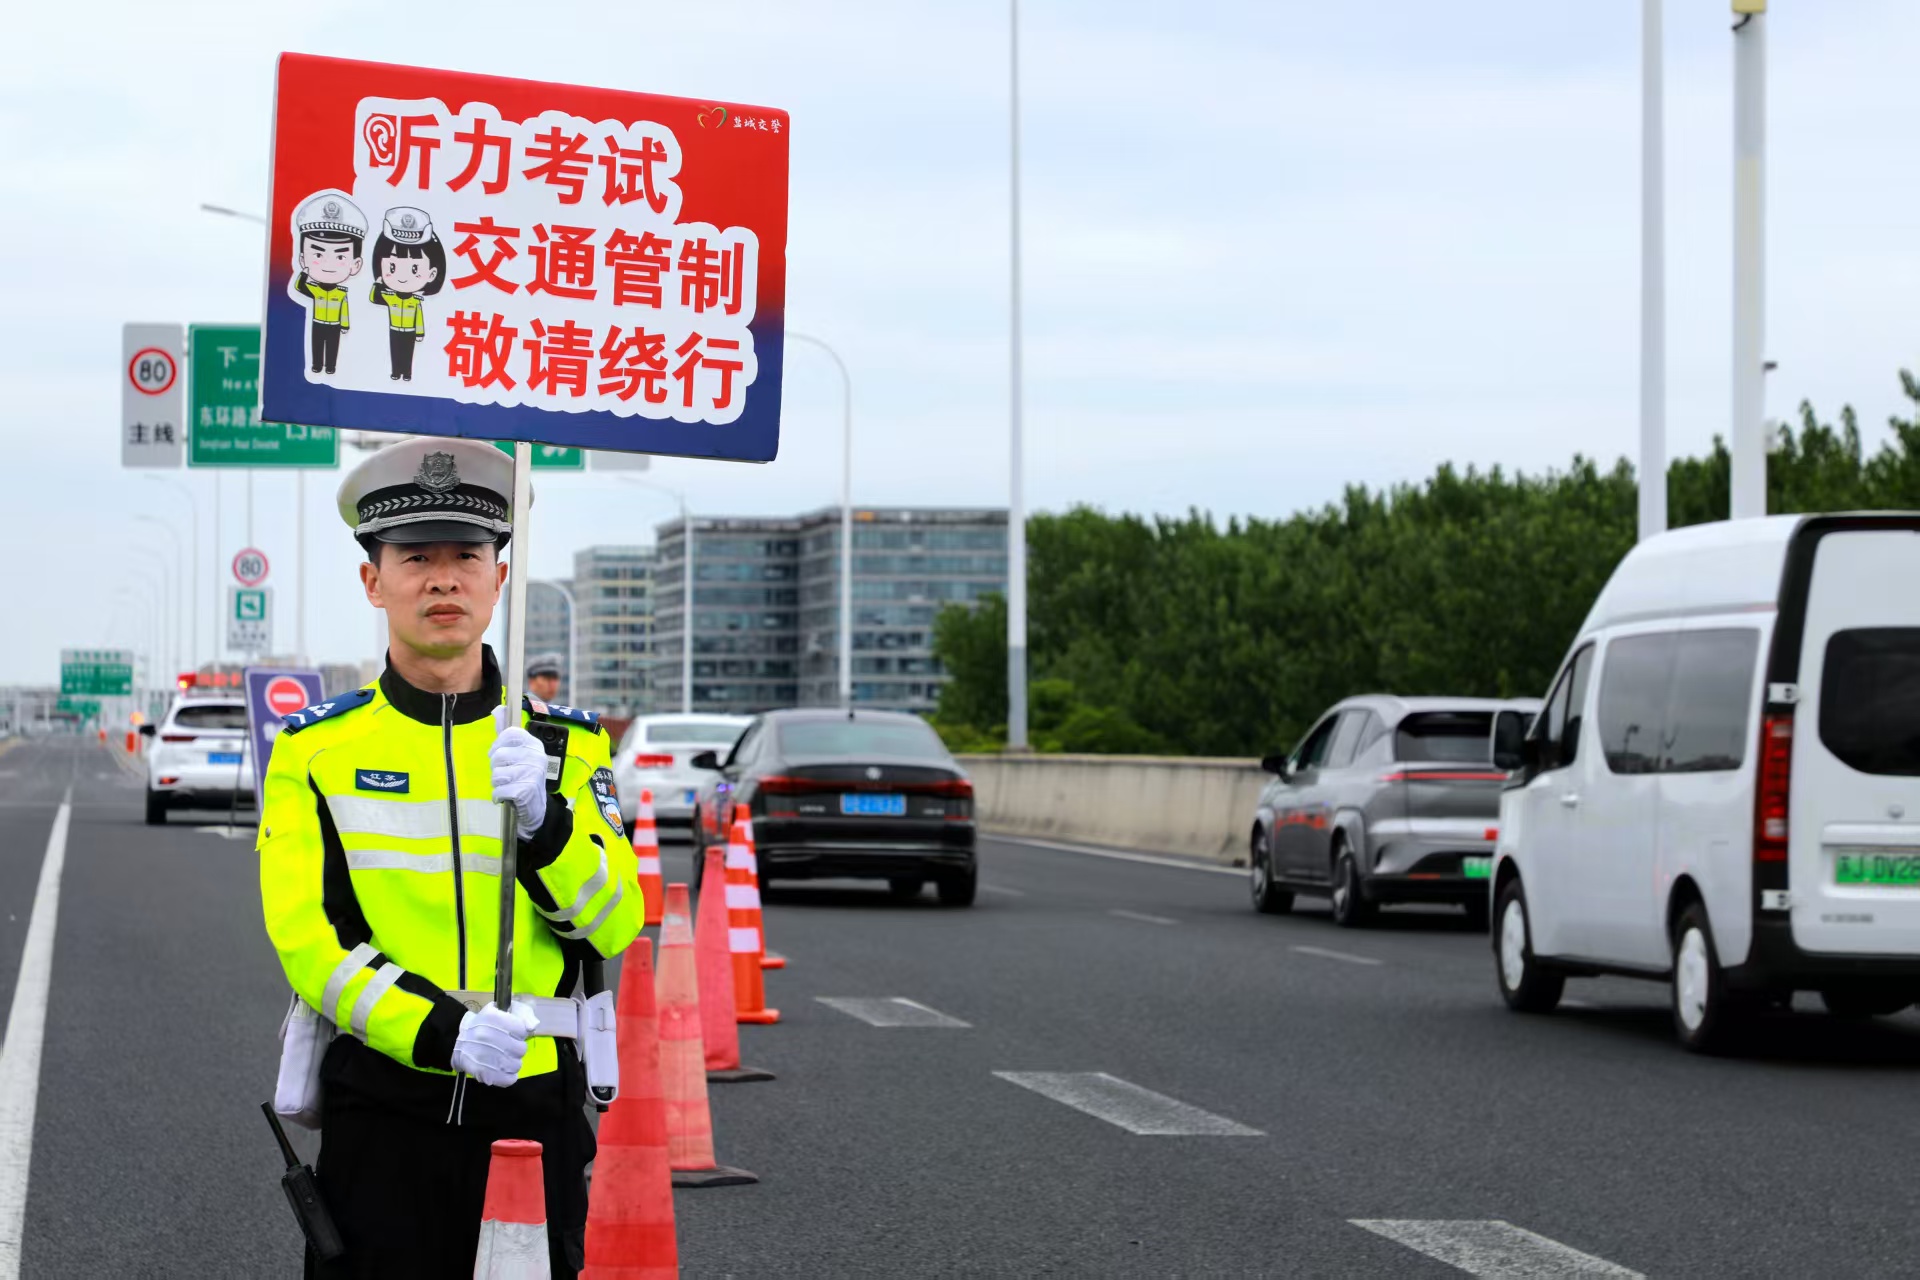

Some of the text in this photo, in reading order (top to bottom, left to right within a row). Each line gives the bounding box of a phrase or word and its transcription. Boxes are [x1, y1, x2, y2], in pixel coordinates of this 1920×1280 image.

[733, 116, 783, 134] 盐城交警
[362, 112, 669, 214] 听力考试
[451, 216, 744, 315] 交通管制
[138, 359, 167, 383] 80
[444, 310, 744, 409] 敬请绕行
[128, 422, 175, 446] 主线
[241, 556, 262, 578] 80
